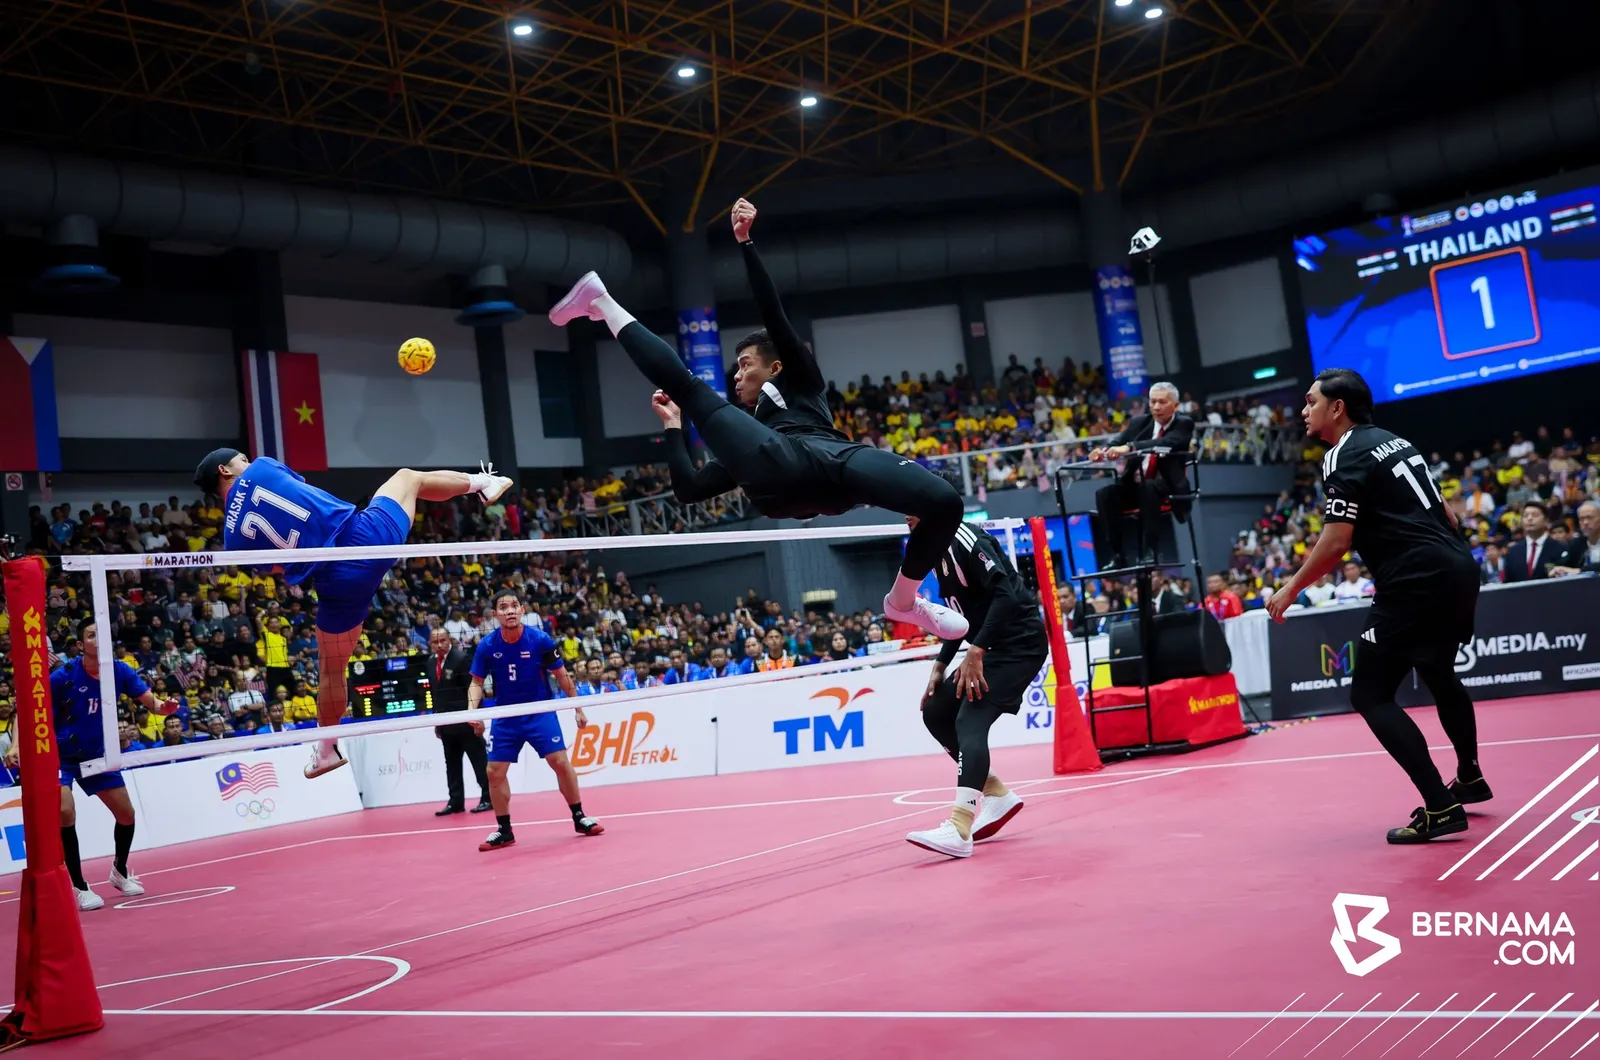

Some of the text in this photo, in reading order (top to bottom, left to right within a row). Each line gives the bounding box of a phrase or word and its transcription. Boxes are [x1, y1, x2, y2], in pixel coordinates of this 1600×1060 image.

[1403, 216, 1543, 266] THAILAND
[1470, 275, 1496, 330] 1
[1370, 438, 1412, 462] MALAYSI
[1391, 454, 1442, 510] 17
[225, 489, 247, 534] JIRASAK
[240, 485, 311, 550] 21
[154, 554, 213, 566] MARATHON
[26, 634, 50, 754] MARATHON
[508, 664, 517, 681] 5
[1291, 678, 1338, 692] MEDIA
[1460, 670, 1543, 687] MEDIA PARTNER
[773, 710, 865, 755] TM
[1026, 710, 1053, 729] KJ
